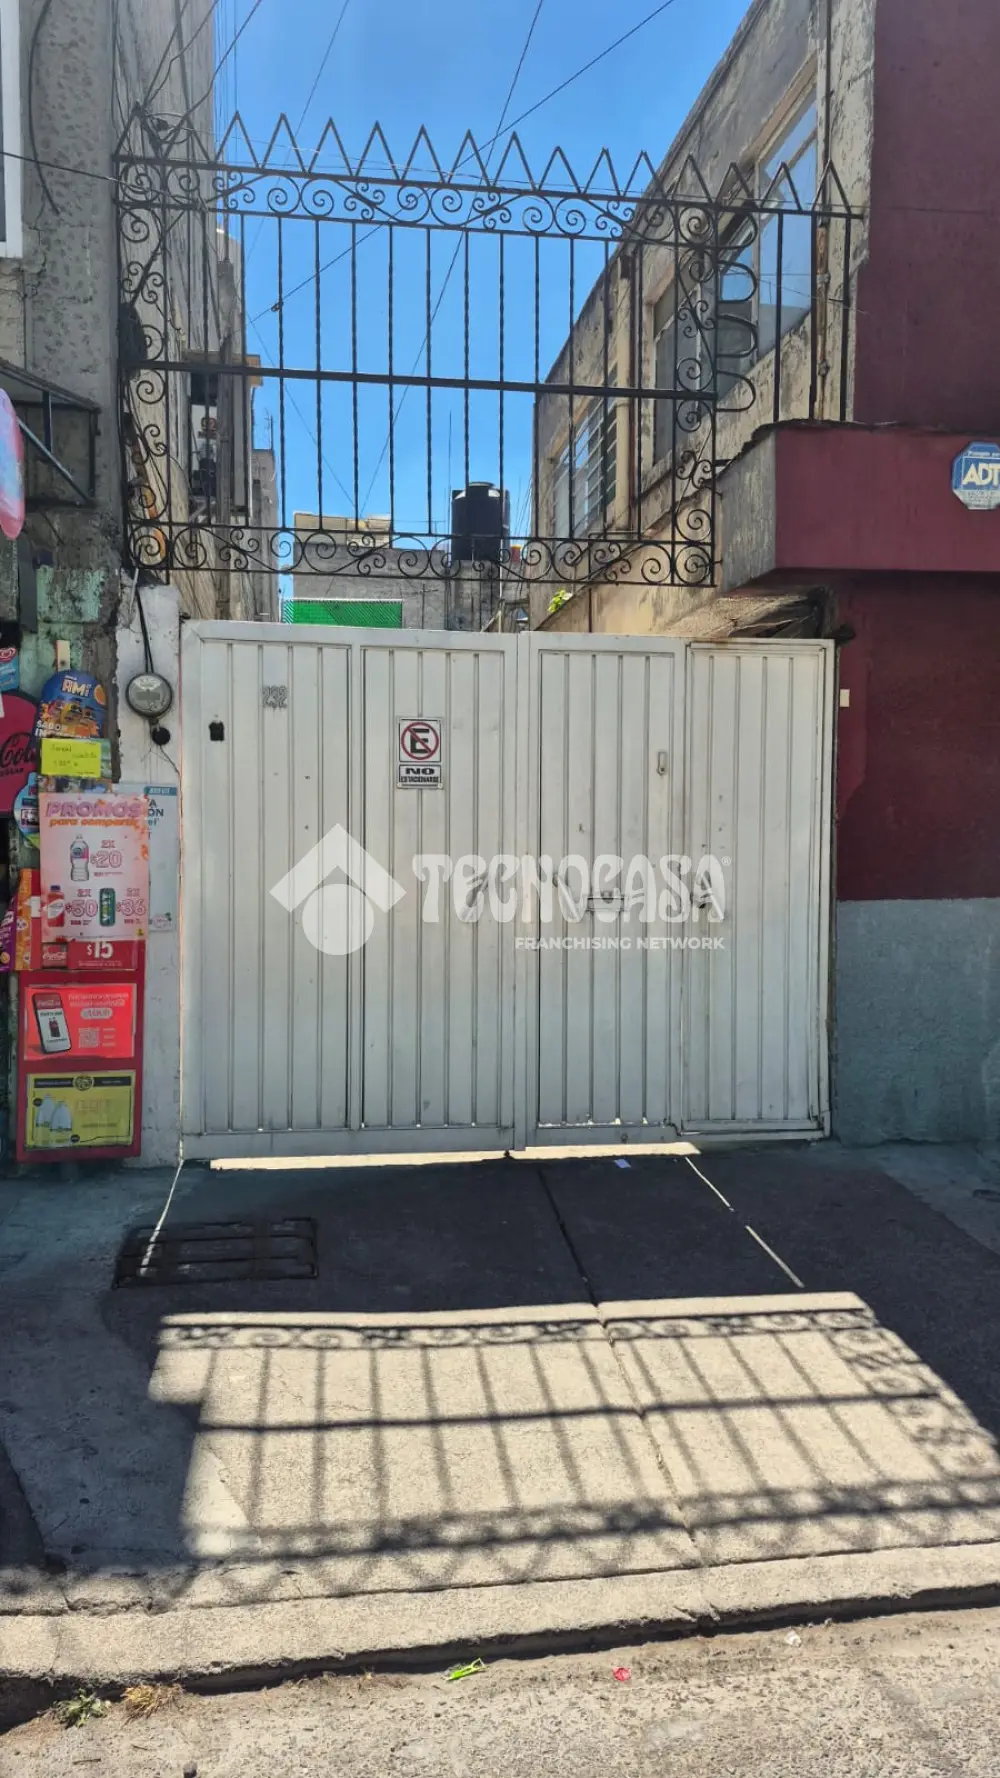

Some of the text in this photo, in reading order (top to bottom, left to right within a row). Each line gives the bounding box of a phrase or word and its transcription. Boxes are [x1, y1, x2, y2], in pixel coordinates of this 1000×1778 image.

[963, 463, 1000, 487] ADT
[405, 767, 435, 775] NO
[45, 801, 143, 818] PROMOS
[90, 850, 122, 869] $20
[65, 899, 98, 918] $50
[87, 939, 114, 959] $15
